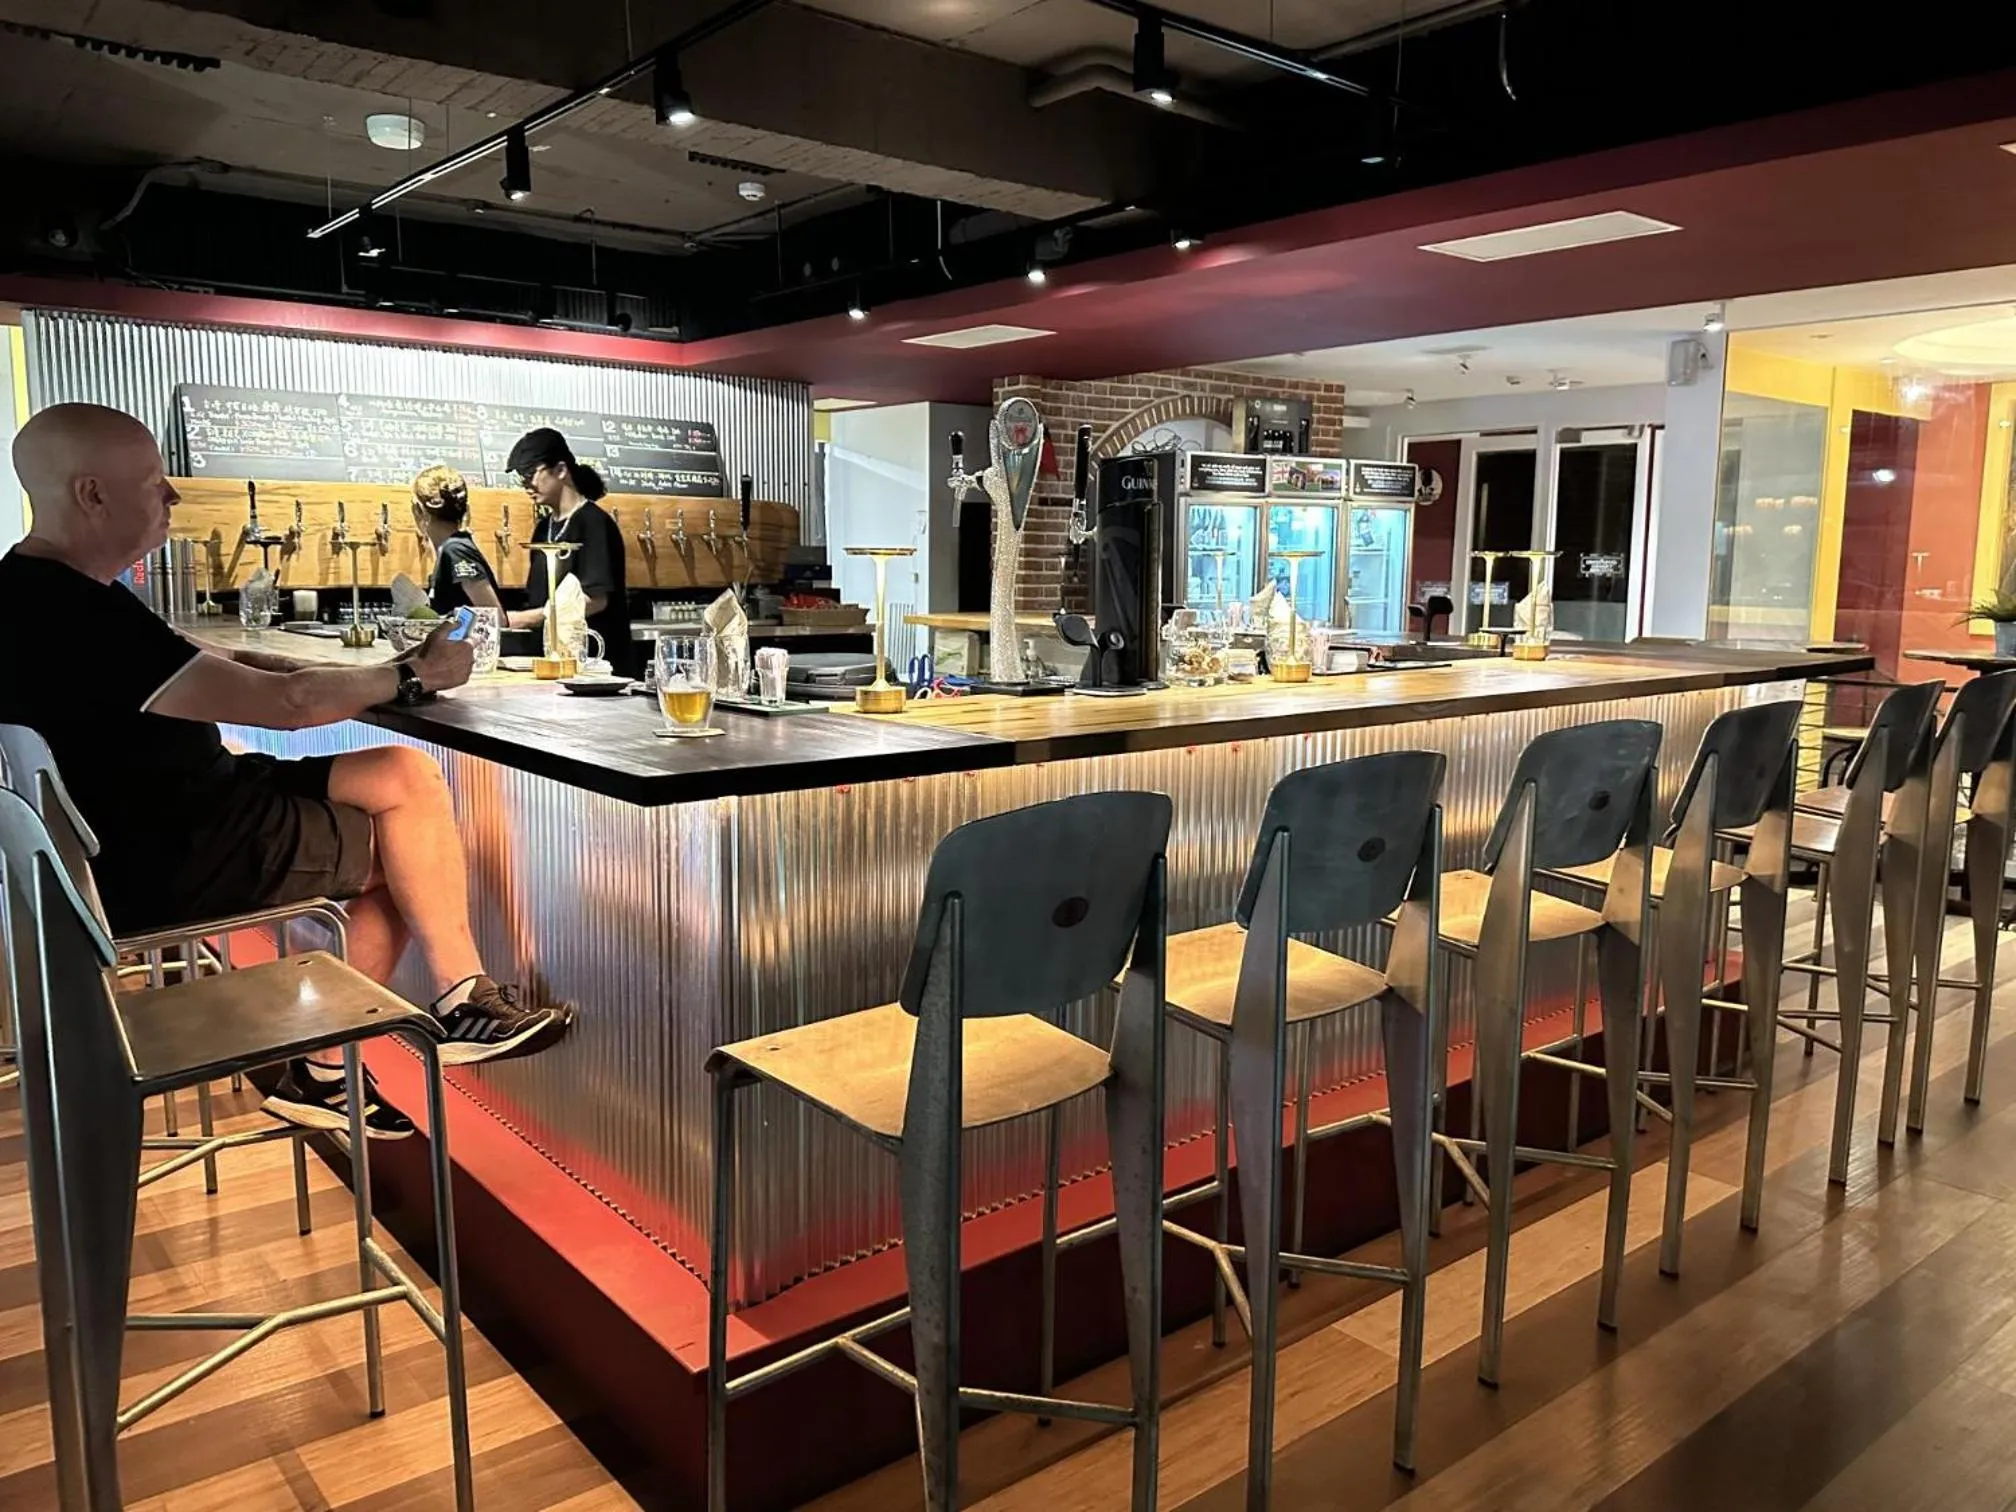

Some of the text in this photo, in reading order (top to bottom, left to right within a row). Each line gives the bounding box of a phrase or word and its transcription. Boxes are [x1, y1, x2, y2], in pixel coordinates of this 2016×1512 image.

[182, 395, 195, 412] 1
[186, 425, 202, 440] 2
[602, 421, 617, 433] 12
[606, 446, 619, 458] 13
